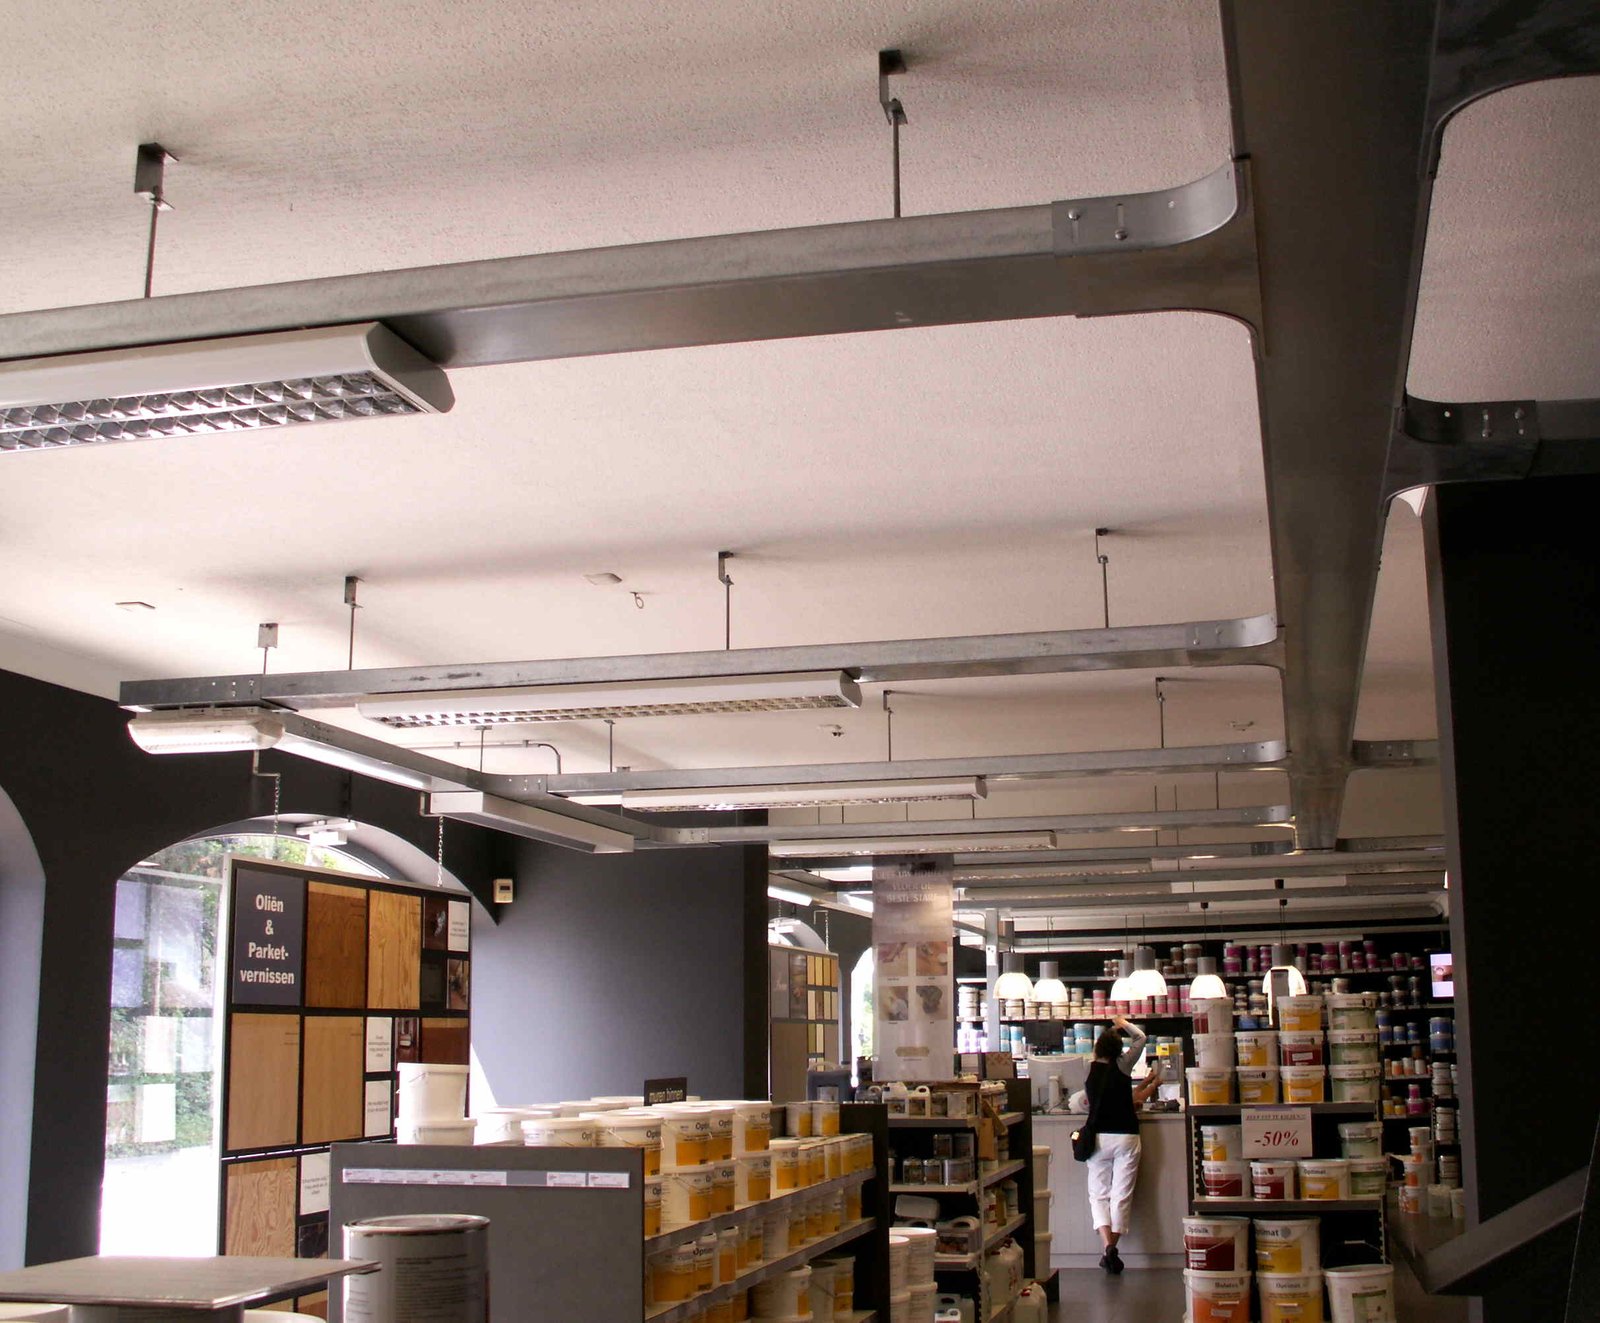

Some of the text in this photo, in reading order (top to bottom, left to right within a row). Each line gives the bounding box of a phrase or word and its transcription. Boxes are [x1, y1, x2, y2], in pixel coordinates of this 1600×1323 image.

[255, 894, 284, 913] Oliën
[265, 919, 274, 935] &
[248, 942, 289, 961] Parket-
[239, 968, 295, 984] vernissen
[649, 1087, 684, 1103] muren binnen
[1254, 1130, 1299, 1147] -50%
